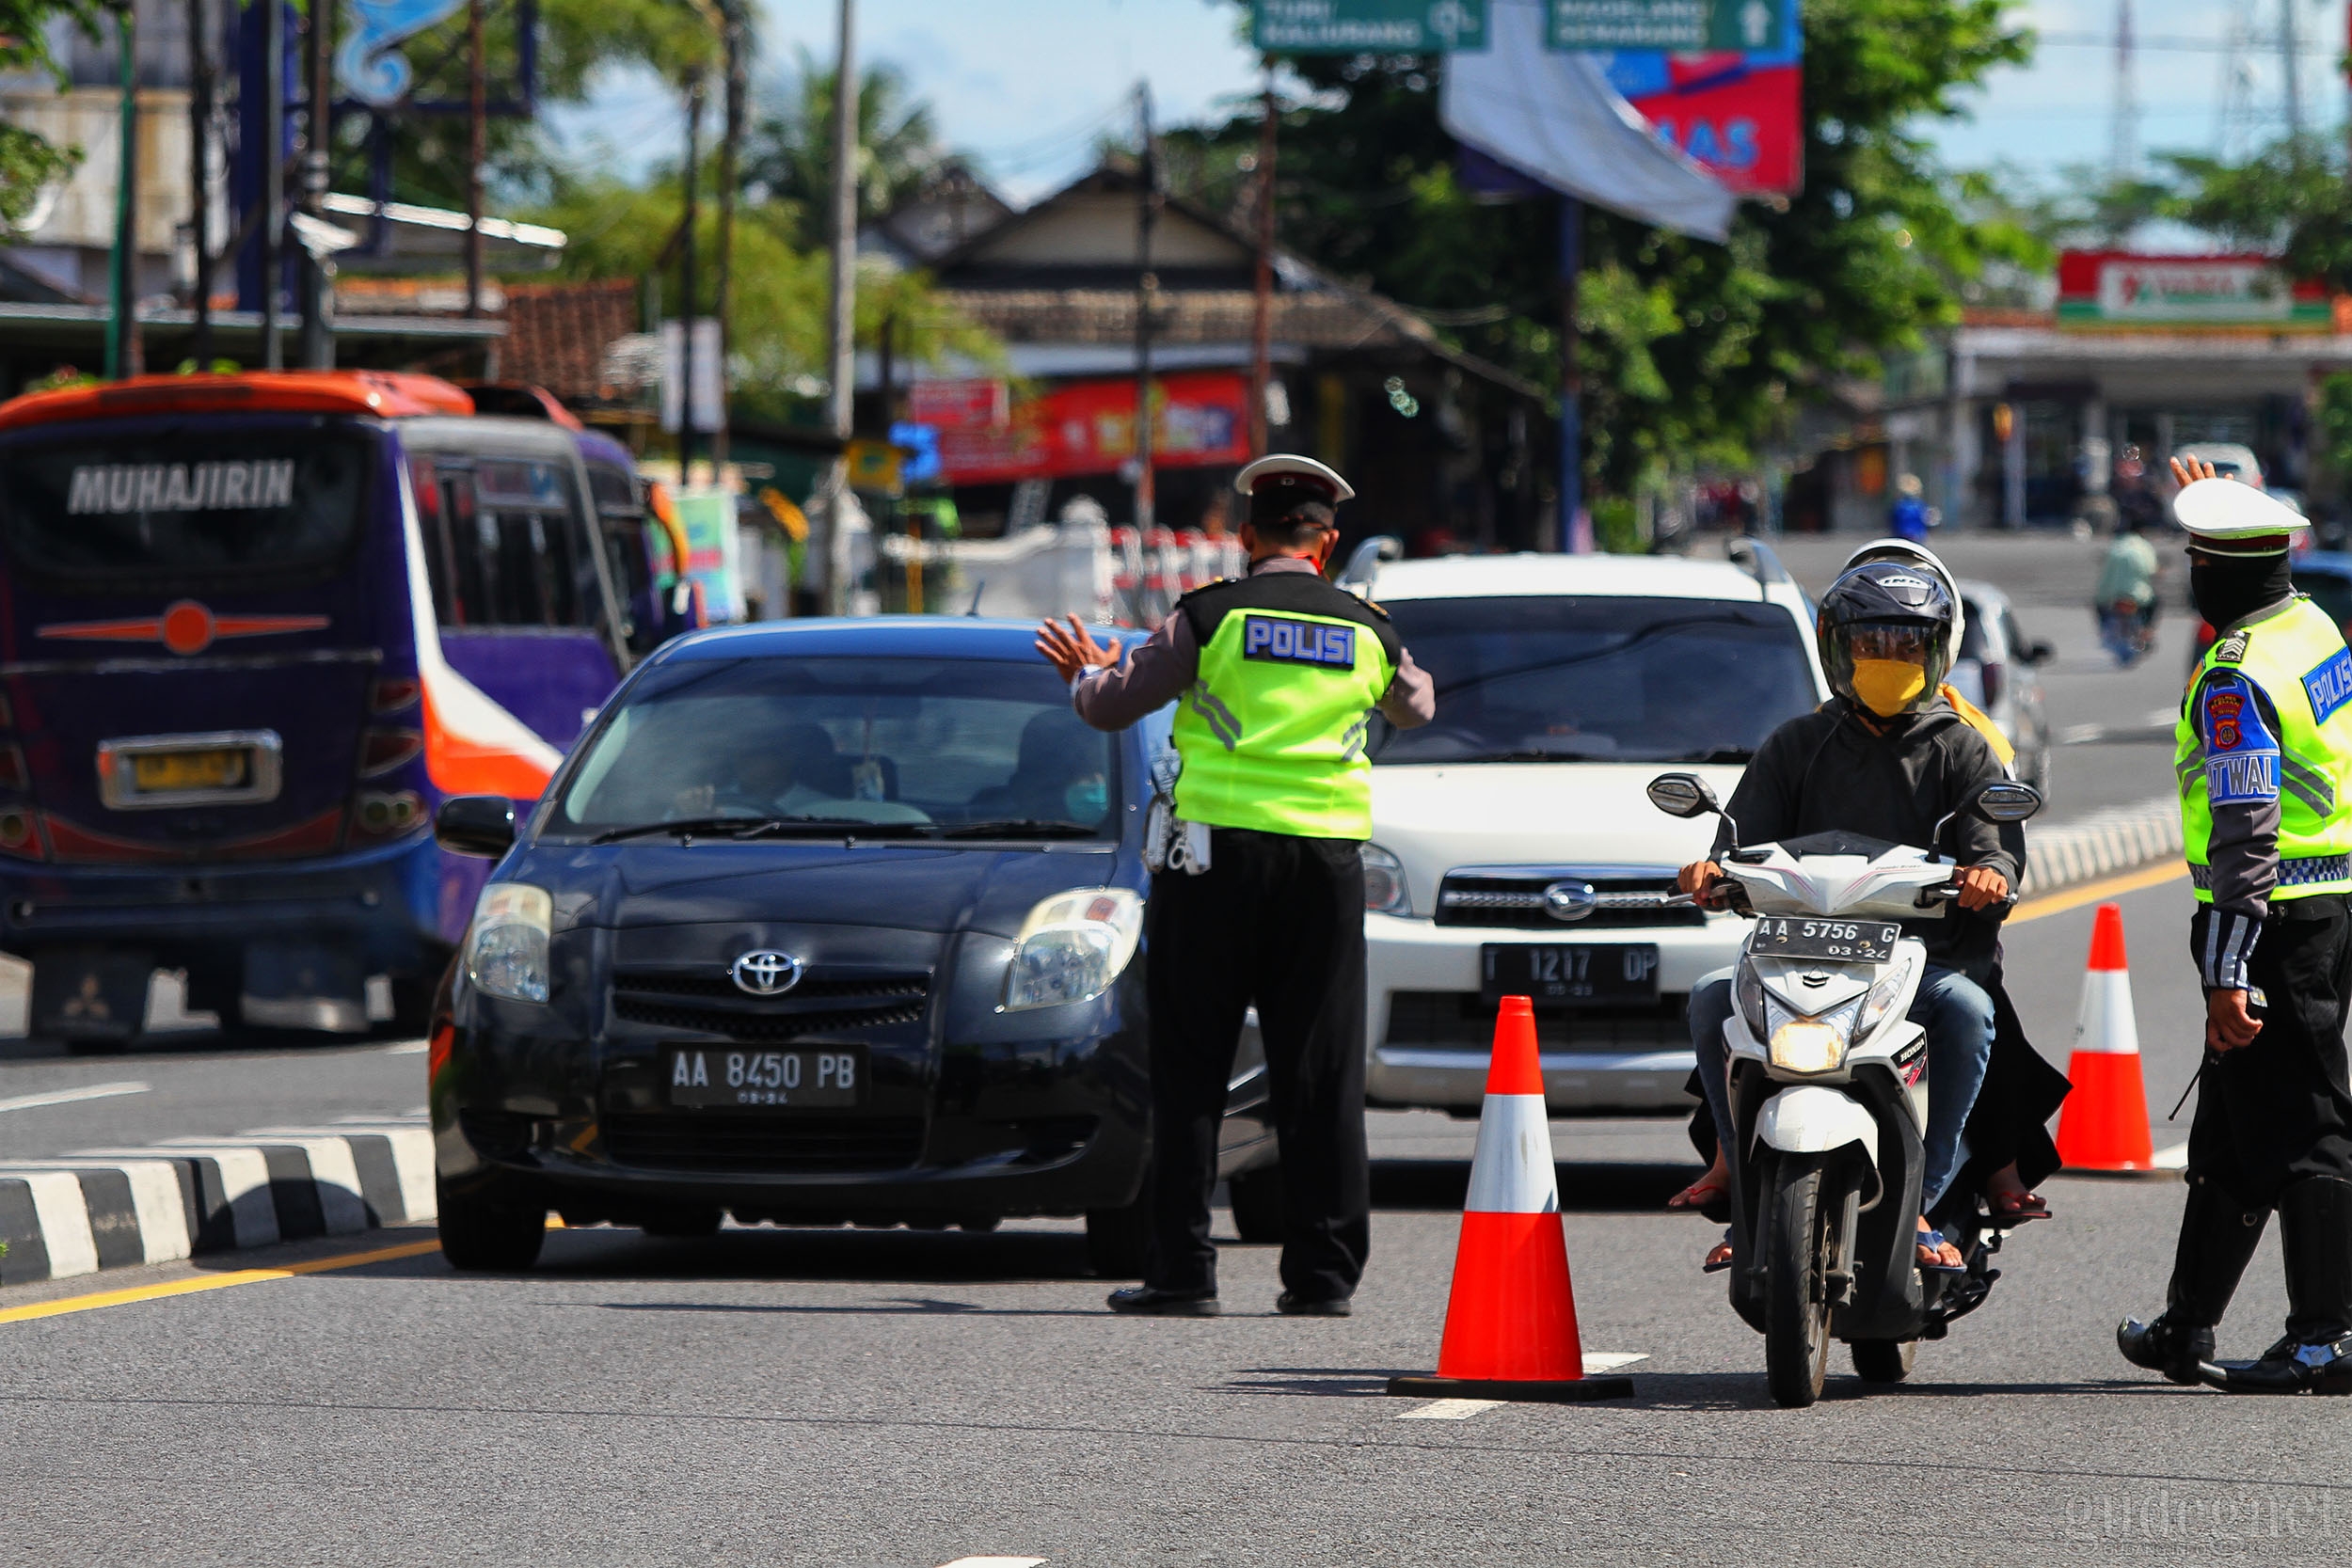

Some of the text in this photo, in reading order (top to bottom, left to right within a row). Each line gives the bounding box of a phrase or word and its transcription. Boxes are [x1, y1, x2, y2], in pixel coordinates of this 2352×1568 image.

[67, 458, 295, 515] MUHAJIRIN
[1247, 619, 1355, 664] POLISI
[1803, 922, 1859, 941] 5756
[1882, 927, 1895, 943] G
[1530, 947, 1592, 982] 1217
[1900, 1037, 1925, 1063] HONDA
[673, 1051, 856, 1088] AA 8450 PB
